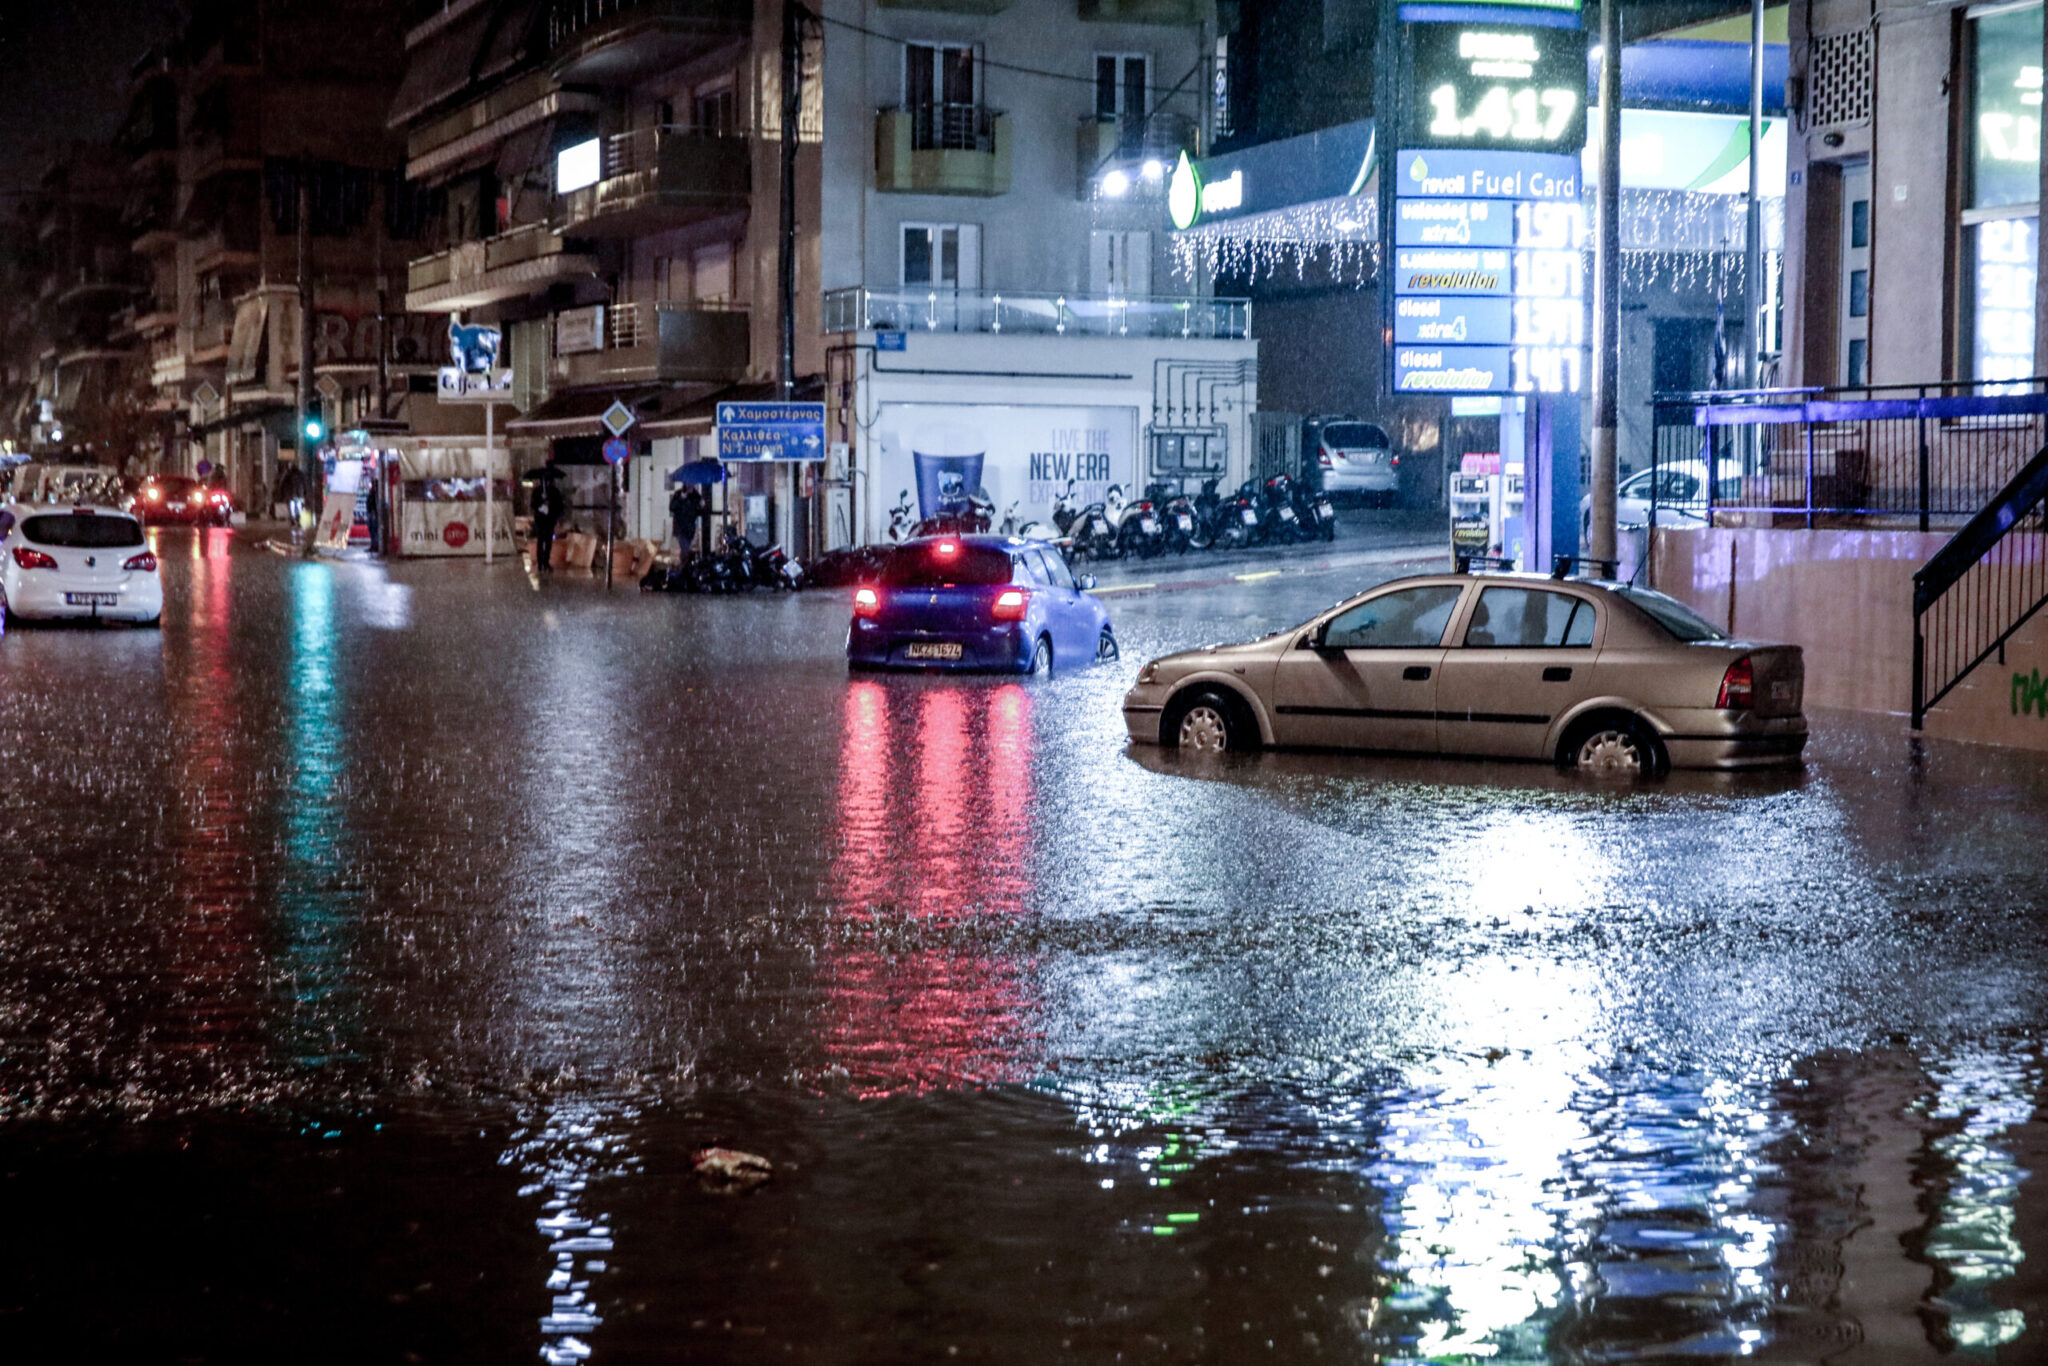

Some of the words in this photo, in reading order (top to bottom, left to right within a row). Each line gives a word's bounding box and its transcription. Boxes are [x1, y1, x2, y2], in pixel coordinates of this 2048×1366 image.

[1429, 84, 1577, 141] 1.417
[1472, 169, 1521, 194] Fuel
[1529, 172, 1575, 197] Card
[1407, 271, 1499, 289] revolution
[1398, 299, 1441, 317] diesel
[1416, 316, 1467, 341] xtra4
[1400, 350, 1442, 368] diesel
[1401, 368, 1494, 389] revolution
[738, 406, 821, 422] Χαμοστέρνας
[722, 428, 781, 441] Καλλιθέα
[1052, 428, 1080, 451] LIVE
[1085, 428, 1110, 451] THE
[1029, 452, 1071, 481] NEW
[1076, 452, 1110, 481] ERA
[411, 528, 438, 541] mini
[474, 528, 509, 541] kisk
